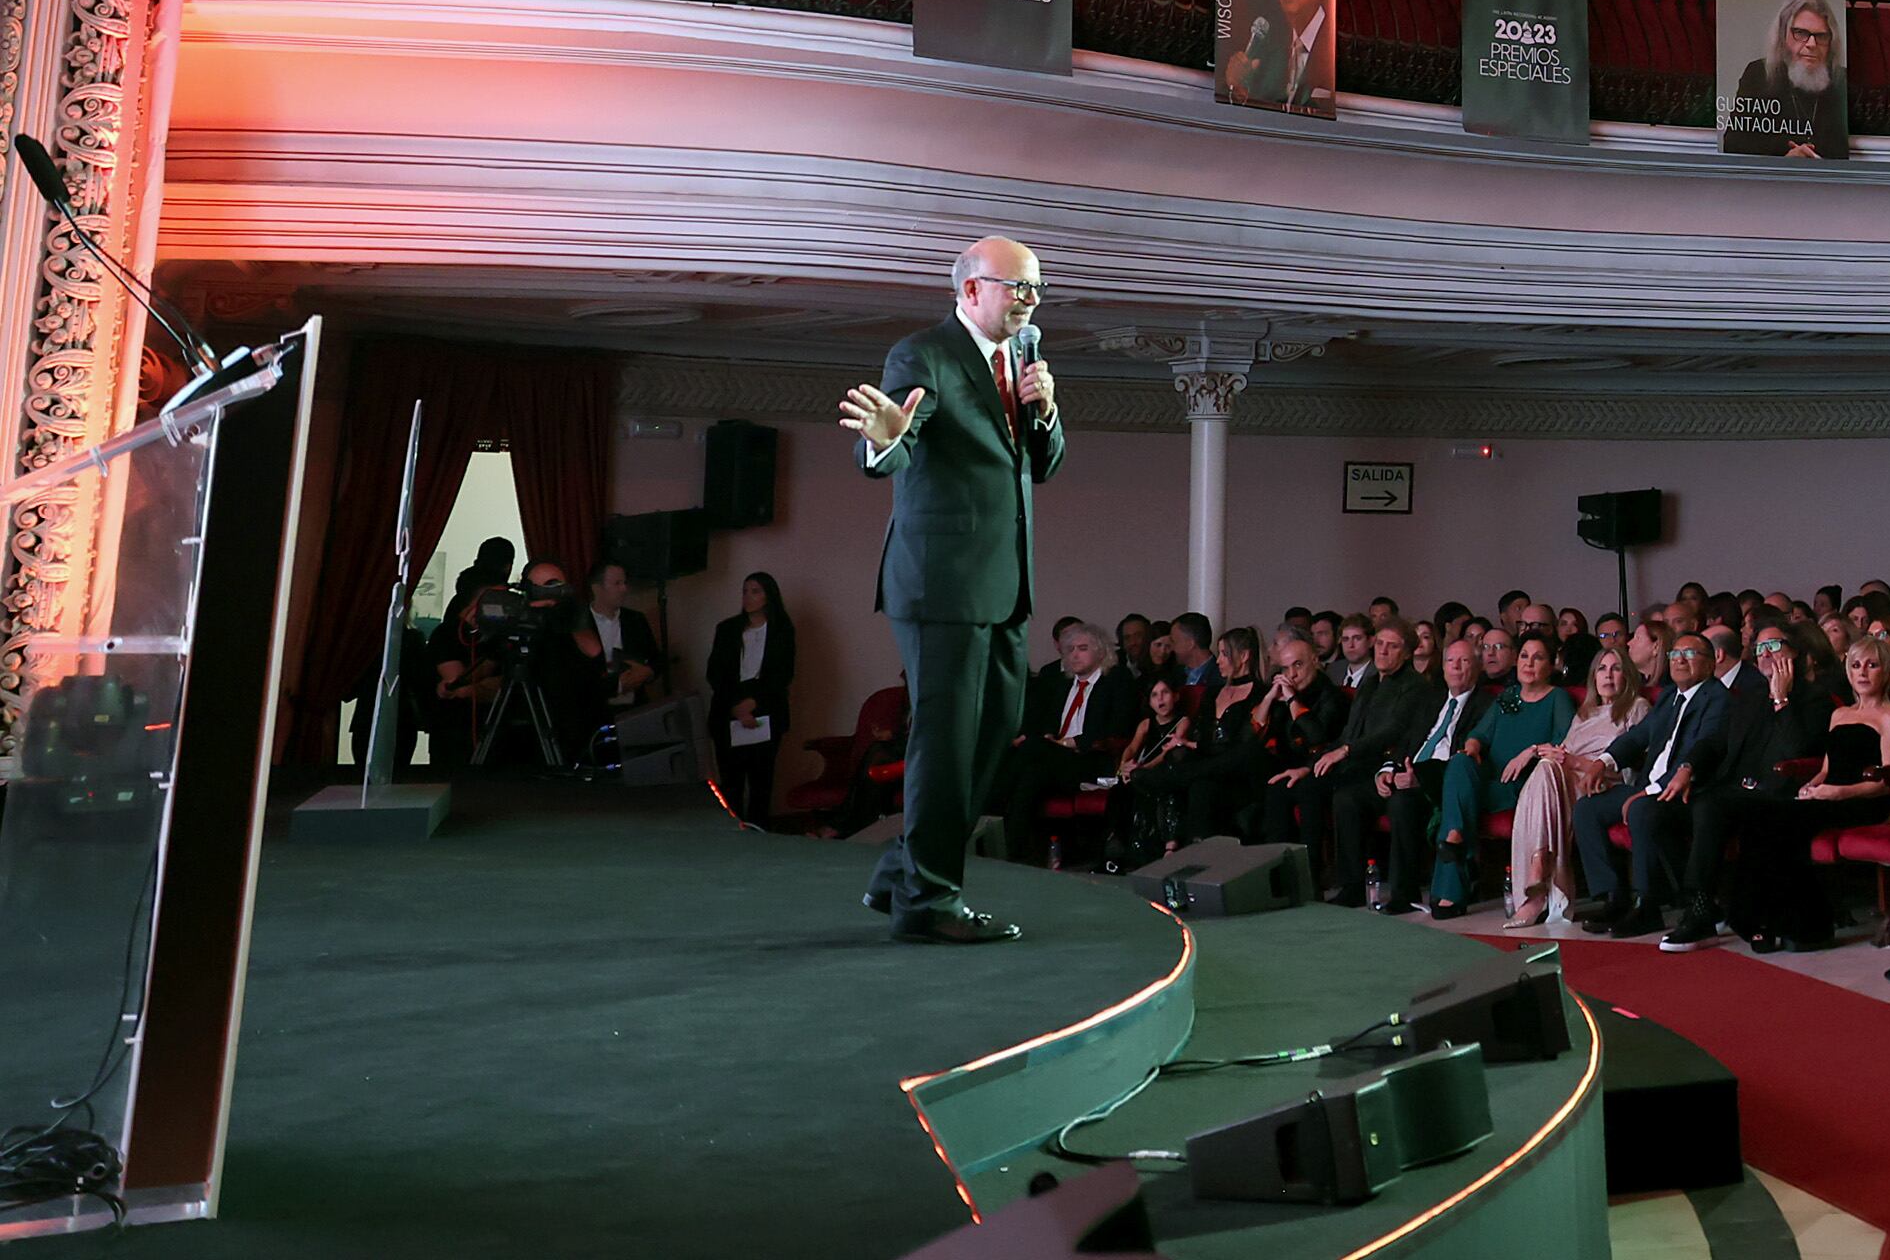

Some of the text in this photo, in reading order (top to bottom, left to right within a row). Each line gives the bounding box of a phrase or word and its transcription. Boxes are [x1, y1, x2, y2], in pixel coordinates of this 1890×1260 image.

[1490, 42, 1560, 66] PREMIOS
[1479, 58, 1572, 85] ESPECIALES
[1716, 96, 1781, 115] GUSTAVO
[1716, 115, 1814, 136] SANTAOLALLA
[1352, 468, 1404, 481] SALIDA
